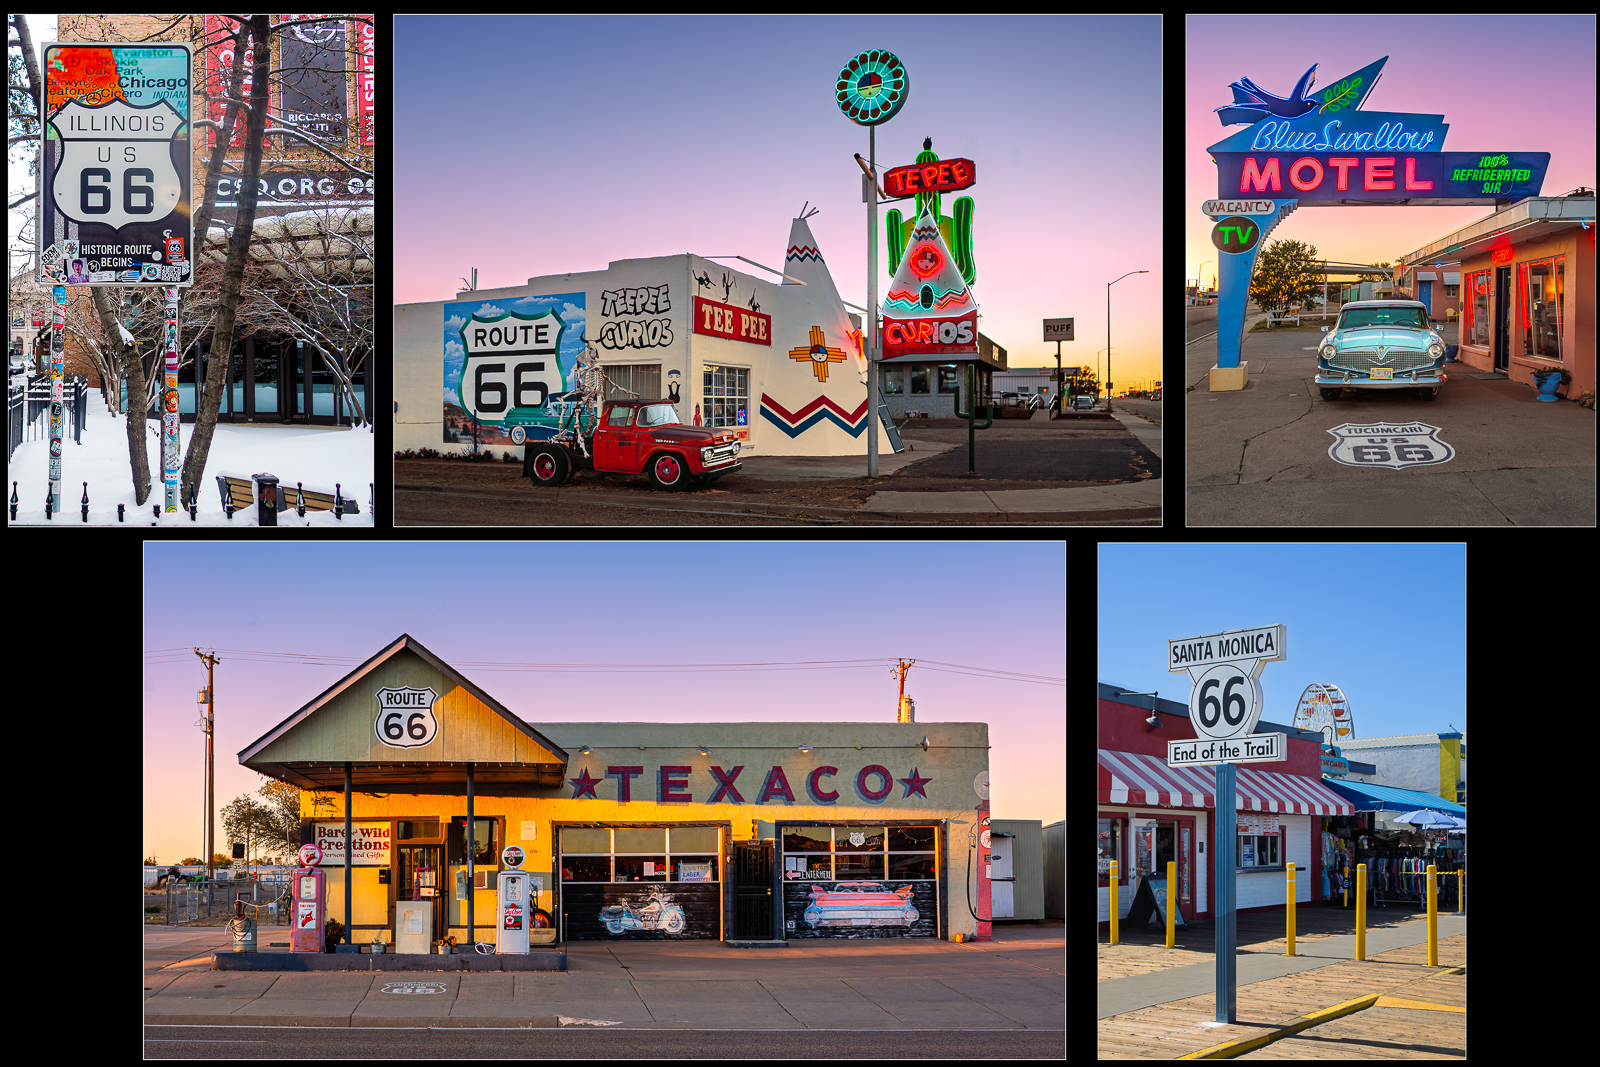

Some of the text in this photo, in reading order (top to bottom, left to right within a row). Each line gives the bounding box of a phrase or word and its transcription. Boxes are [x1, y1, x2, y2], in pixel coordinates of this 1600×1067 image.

[115, 49, 173, 57] Evanston
[96, 57, 138, 66] Skokie
[85, 66, 144, 75] Oak Park
[47, 79, 86, 88] Berwyn
[118, 76, 188, 90] Chicago
[101, 88, 143, 98] Cicero
[70, 115, 164, 131] ILLINOIS
[1251, 119, 1434, 152] Blue Swallow
[1479, 154, 1509, 168] 100%
[890, 162, 968, 191] TEPEE
[1240, 156, 1434, 193] MOTEL
[1452, 169, 1531, 181] REFRIGERATED
[80, 168, 154, 214] 66
[1482, 181, 1501, 193] AIR
[1207, 201, 1272, 212] VACANCY
[1218, 226, 1253, 244] TV
[81, 245, 152, 255] HISTORIC ROUTE
[101, 257, 133, 267] BEGINS
[601, 283, 672, 318] TEEPEE
[701, 303, 768, 341] TEE PEE
[1045, 324, 1072, 333] PUFF
[474, 324, 549, 347] ROUTE
[599, 318, 674, 351] CURIOS
[885, 320, 973, 346] CURIOS
[474, 362, 549, 413] 66
[1345, 425, 1424, 435] TUCUMCARI
[1353, 444, 1434, 463] 66
[1172, 632, 1275, 664] SANTA MONICA
[386, 692, 426, 706] ROUTE
[1199, 675, 1246, 728] 66
[383, 712, 427, 740] 66
[1173, 738, 1273, 762] End of the Trail
[605, 764, 894, 805] TEXACO
[318, 827, 346, 838] Bare
[359, 827, 390, 838] Wild
[318, 838, 390, 850] Cretions
[366, 852, 384, 860] Gifts
[801, 870, 832, 879] ENTER HERE
